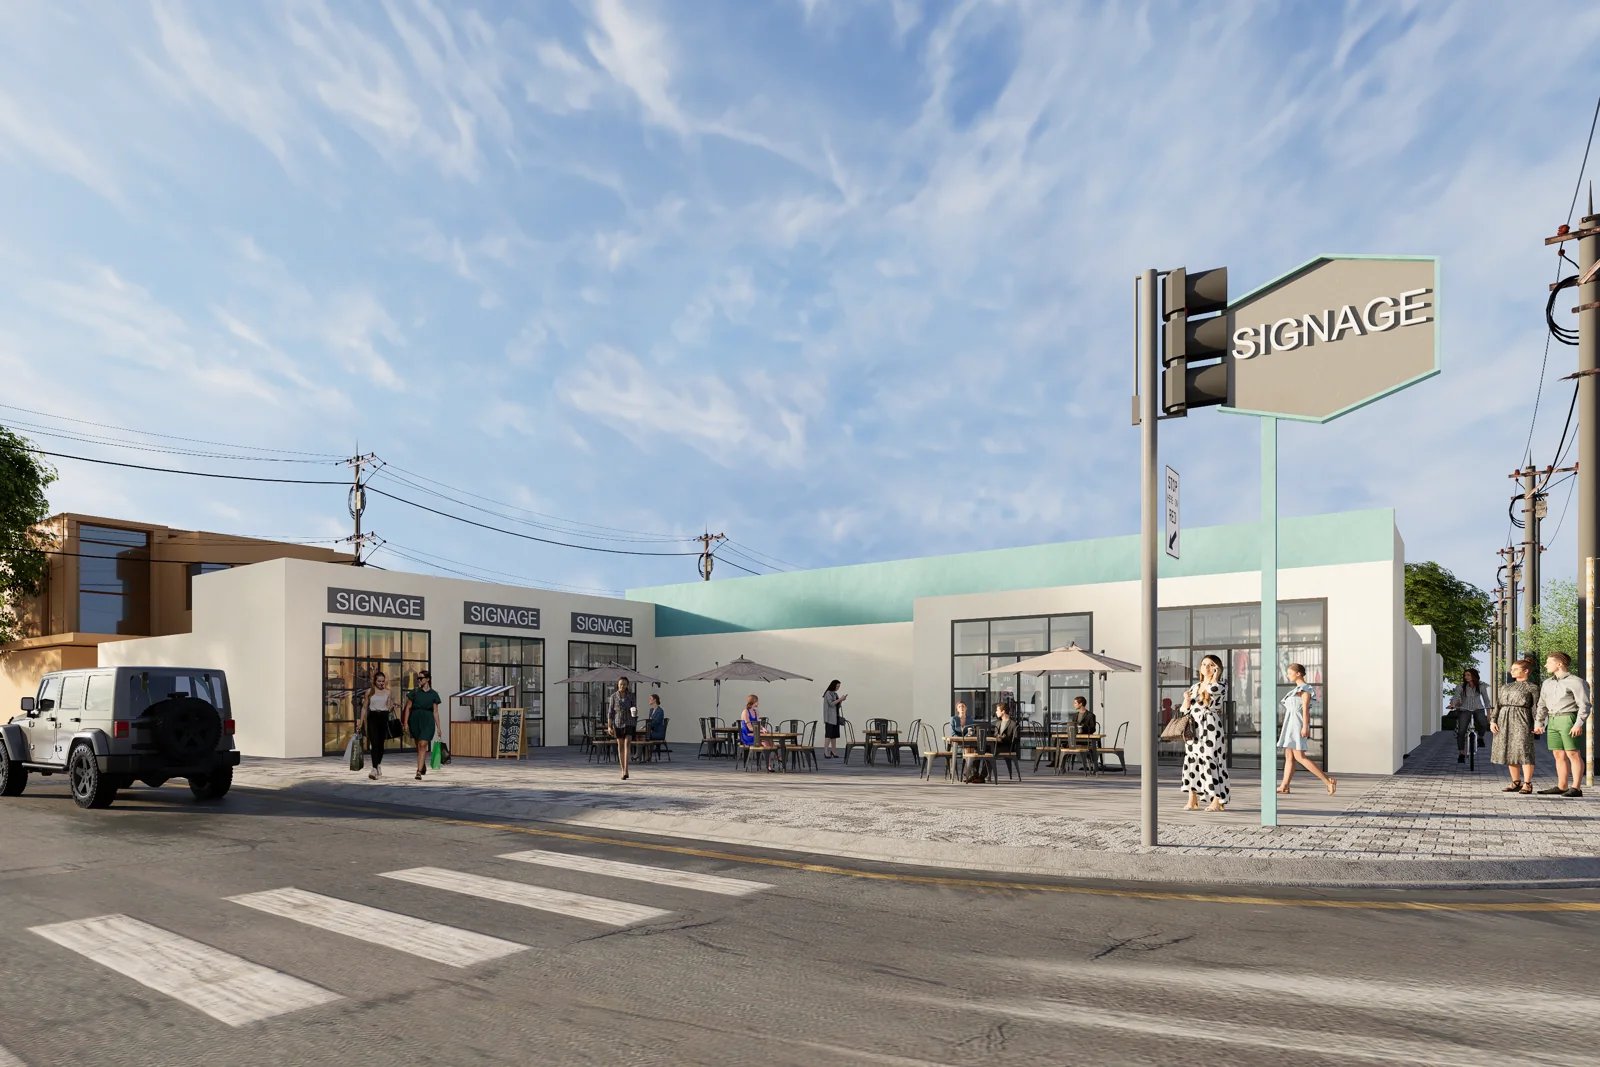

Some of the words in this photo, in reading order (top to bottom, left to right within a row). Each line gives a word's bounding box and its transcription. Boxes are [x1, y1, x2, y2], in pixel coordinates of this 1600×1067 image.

[1232, 288, 1428, 359] SIGNAGE
[336, 592, 421, 617] SIGNAGE
[470, 605, 538, 627] SIGNAGE
[576, 616, 631, 635] SIGNAGE
